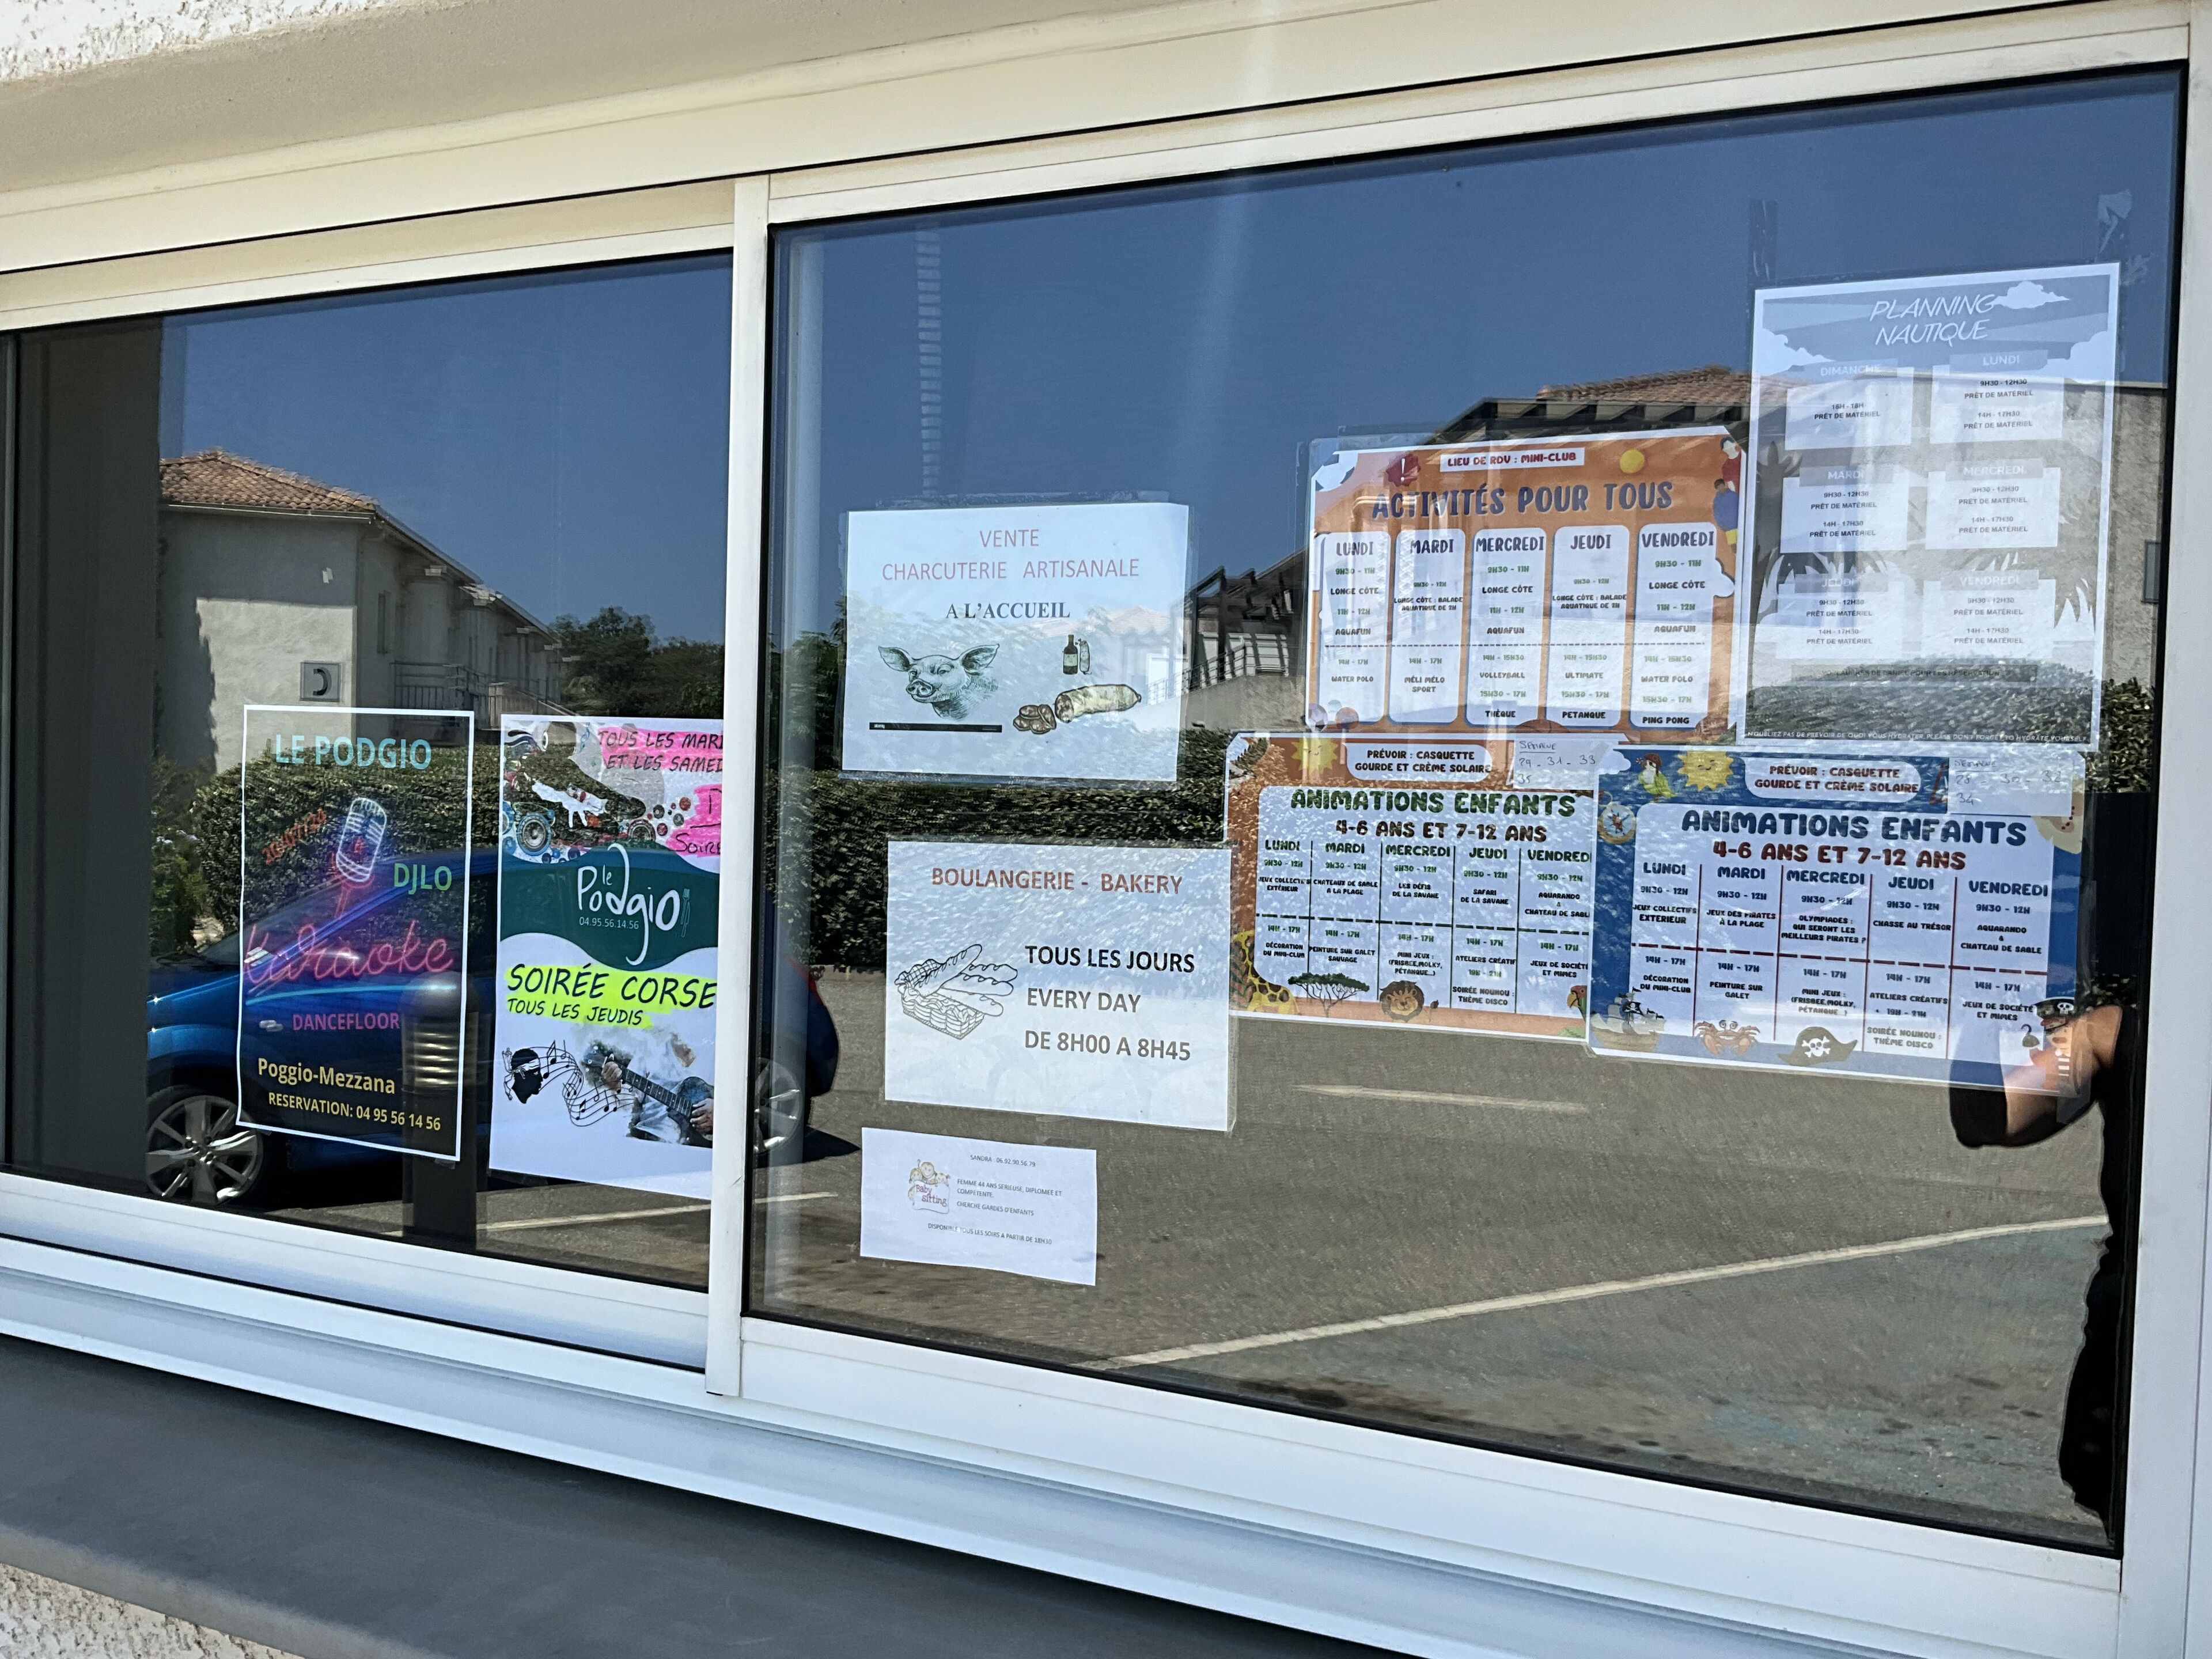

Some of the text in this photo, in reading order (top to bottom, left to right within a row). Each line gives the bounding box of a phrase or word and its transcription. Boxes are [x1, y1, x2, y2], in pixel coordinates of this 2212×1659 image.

[1870, 294, 1995, 321] PLANNING
[1875, 319, 1990, 347] NAUTIQUE
[1983, 355, 2020, 365] LUNDI
[1448, 452, 1577, 467] LIEU DE RDV MINI-CLUB
[1828, 471, 1863, 480] MARDI
[1372, 480, 1673, 519] ACTIVITÉS POUR TOUS
[979, 528, 1039, 547] VENTE
[1476, 536, 1544, 552] MERCREDI
[1570, 534, 1611, 550] JEUDI
[1642, 531, 1714, 548] VENDREDI
[1336, 541, 1374, 556] LUNDI
[1410, 539, 1455, 554] MARDI
[882, 559, 1139, 581] CHARCUTERIE ARTISANALE
[1512, 585, 1533, 593] CÔTE
[1681, 581, 1705, 589] CÔTE
[946, 602, 1070, 619] A L'ACCUEIL
[1485, 709, 1516, 718] THÈQUE
[597, 731, 638, 747] TOUS
[646, 733, 675, 748] LES
[275, 734, 431, 770] LE PODGIO
[1367, 748, 1475, 760] PRÉVOIR CASQUETTE
[1580, 754, 1595, 764] 33
[607, 755, 628, 769] ET
[634, 755, 663, 770] LES
[1355, 763, 1393, 771] GOURDE
[1397, 763, 1410, 771] ET
[1412, 762, 1448, 772] CRÈME
[1770, 765, 1900, 779] PRÉVOIR CASQUETTE
[1754, 779, 1919, 794] GOURDE ET CRÈME SOLAIRE
[1291, 789, 1575, 817] ANIMATIONS ENFANTS
[1336, 819, 1547, 842] 4-6 ANS ET 7-12 ANS
[1681, 809, 2027, 846] ANIMATIONS ENFANTS
[1265, 839, 1300, 851] LUNDI
[1325, 843, 1365, 854] MARDI
[1385, 844, 1450, 857] MERCREDI
[1469, 848, 1507, 859] JEUDI
[1713, 842, 1967, 870] 4-6 ANS ET 7-12 ANS
[1643, 862, 1686, 876] LUNDI
[1717, 866, 1765, 880] MARDI
[394, 863, 452, 895] DJLO
[932, 868, 1075, 890] BOULANGERIE
[1101, 873, 1183, 895] BAKERY
[1786, 869, 1865, 885] MERCREDI
[1888, 877, 1934, 891] JEUDI
[1969, 880, 2048, 897] VENDREDI
[577, 843, 681, 965] Podgio
[579, 917, 639, 929] 04.95.56.14.56
[1921, 922, 1951, 931] TRÉSOR
[1977, 925, 2027, 933] AQUARANDO
[1025, 945, 1195, 973] TOUS LES JOURS
[507, 963, 718, 1009] SOIRÉE CORSE
[1028, 987, 1141, 1013] EVERY DAY
[507, 998, 643, 1025] TOUS LES JEUDIS
[293, 1013, 400, 1031] DANCEFLOOR
[1025, 1031, 1191, 1060] DE 8H00 A 8H45
[258, 1058, 396, 1094] Poggio-Mezzana
[268, 1092, 441, 1130] RESERVATION: 04 95 56 14 56
[916, 1184, 932, 1196] Baby
[957, 1179, 977, 1187] FEMME
[922, 1194, 947, 1207] sitting
[957, 1201, 1034, 1216] CHERCHE GARDES D'ENFANTS
